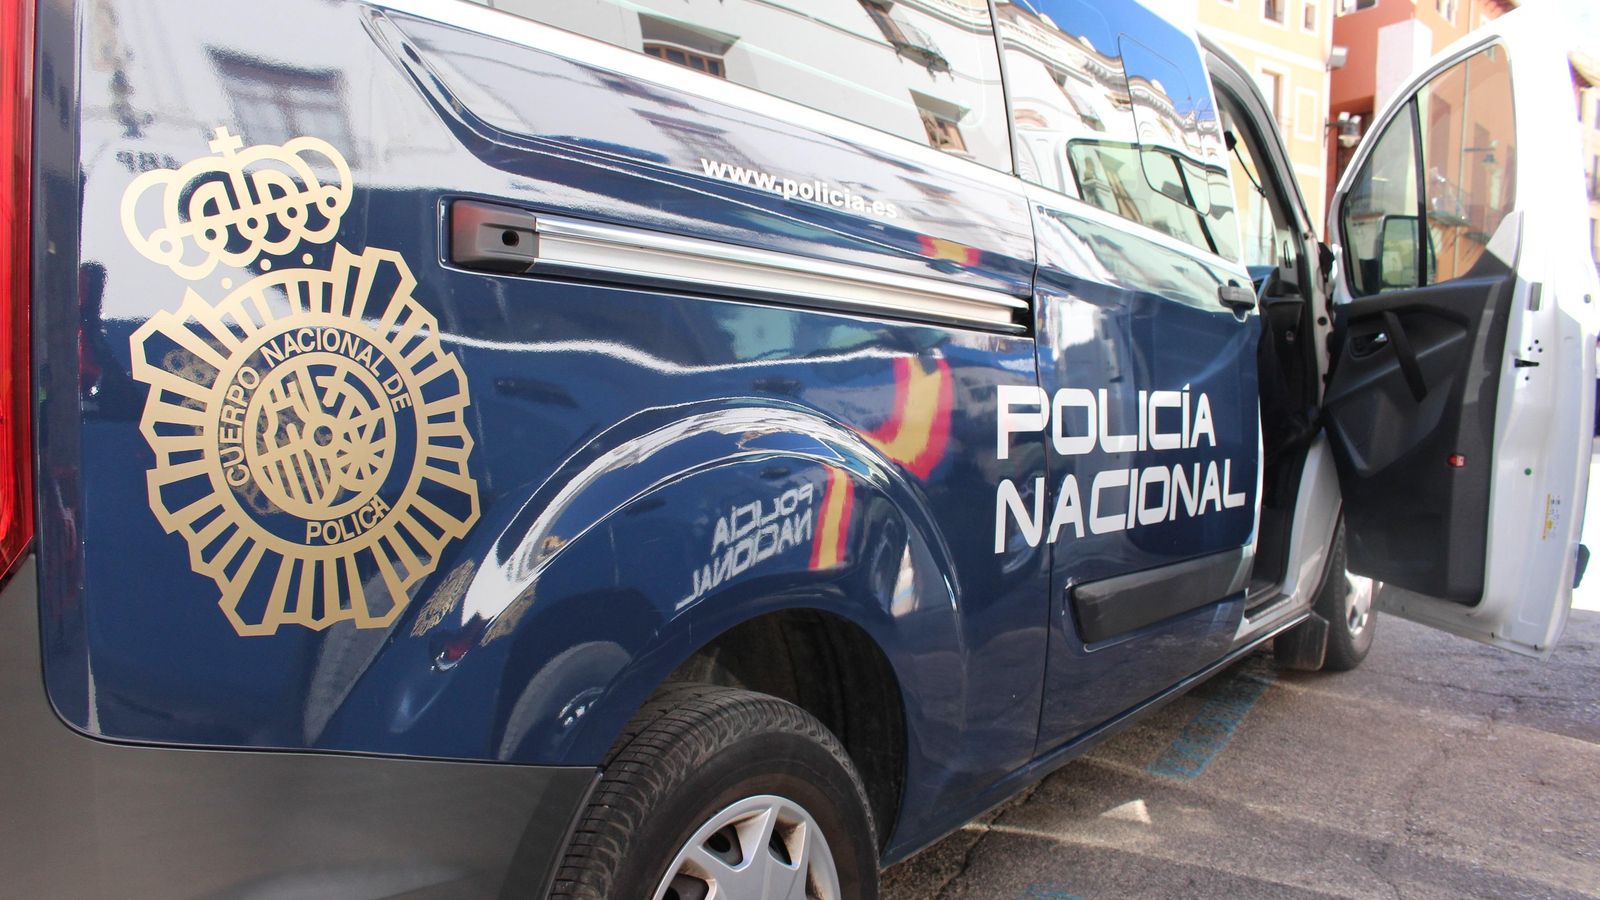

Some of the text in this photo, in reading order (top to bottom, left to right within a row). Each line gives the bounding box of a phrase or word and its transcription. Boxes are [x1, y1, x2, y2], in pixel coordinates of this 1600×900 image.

[700, 158, 898, 219] www.policia.es
[219, 327, 413, 487] CUERPO NACIONAL DE
[996, 383, 1217, 460] POLICÍA
[994, 458, 1246, 554] NACIONAL
